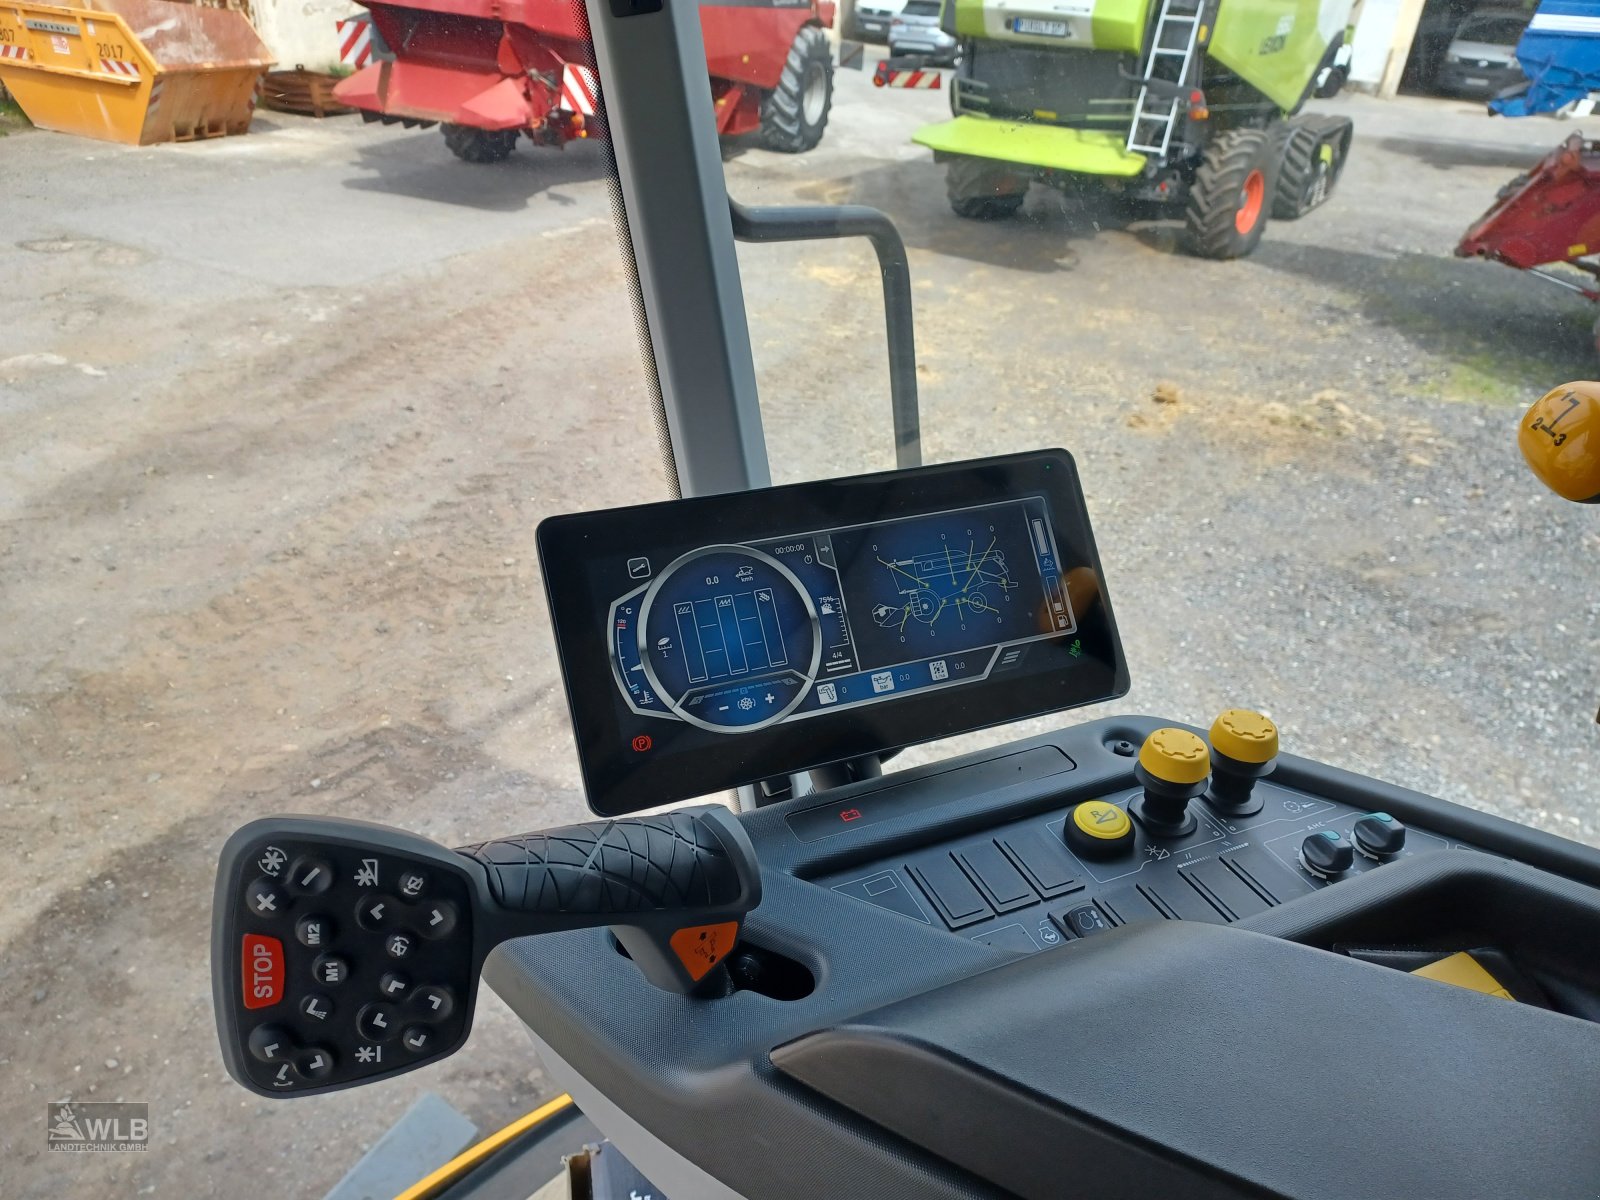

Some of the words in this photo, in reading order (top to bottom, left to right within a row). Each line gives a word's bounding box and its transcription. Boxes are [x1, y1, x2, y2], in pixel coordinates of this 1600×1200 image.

[96, 42, 123, 59] 2017
[1531, 417, 1544, 431] 2
[1554, 433, 1567, 447] 3
[774, 543, 805, 555] 00:00:00
[705, 575, 720, 586] 0.0
[832, 651, 843, 659] 4/4
[954, 662, 966, 670] 0.0
[899, 673, 911, 682] 0.0
[1090, 810, 1102, 819] R
[1306, 821, 1327, 832] AHC
[307, 922, 321, 945] M2
[253, 943, 273, 999] STOP
[325, 961, 339, 982] M1
